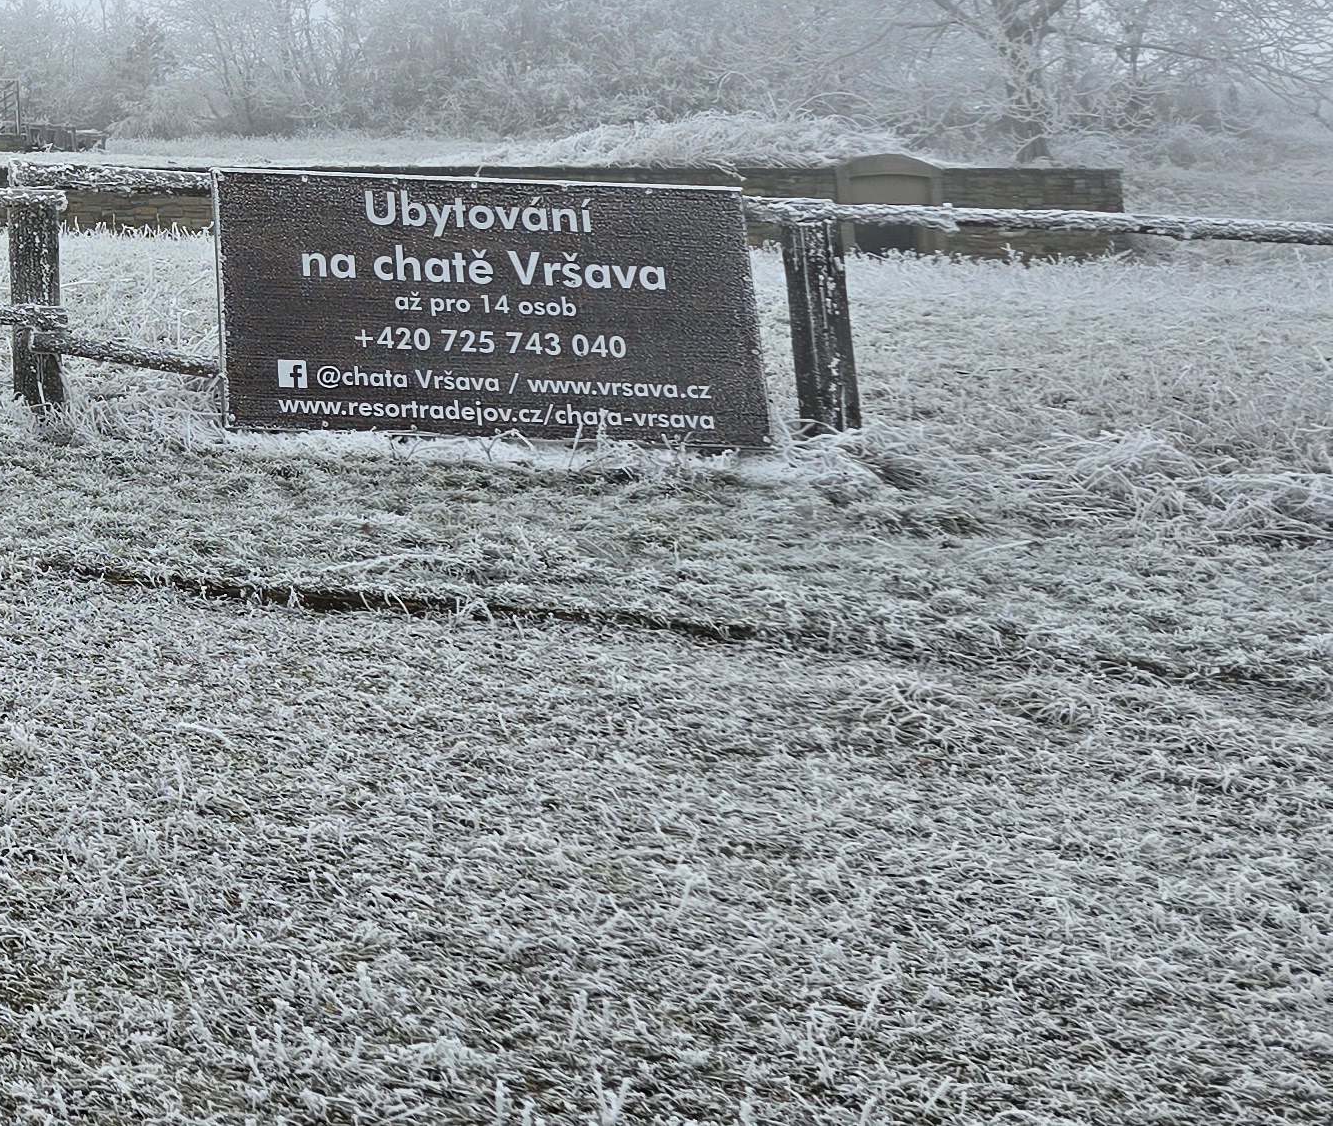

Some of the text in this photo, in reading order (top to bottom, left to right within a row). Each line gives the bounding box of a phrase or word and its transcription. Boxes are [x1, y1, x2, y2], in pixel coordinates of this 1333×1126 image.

[365, 190, 592, 238] Ubytování
[301, 246, 666, 290] na chatě Vršava
[395, 293, 576, 317] až pro 14 osob
[354, 327, 626, 358] +420 725 743 040
[317, 365, 407, 389] @chata
[415, 369, 500, 393] Vršava
[509, 372, 518, 394] /
[527, 377, 711, 399] www.vrsava.cz
[278, 397, 714, 430] www.resortradejov.cz/chata-vrsava
